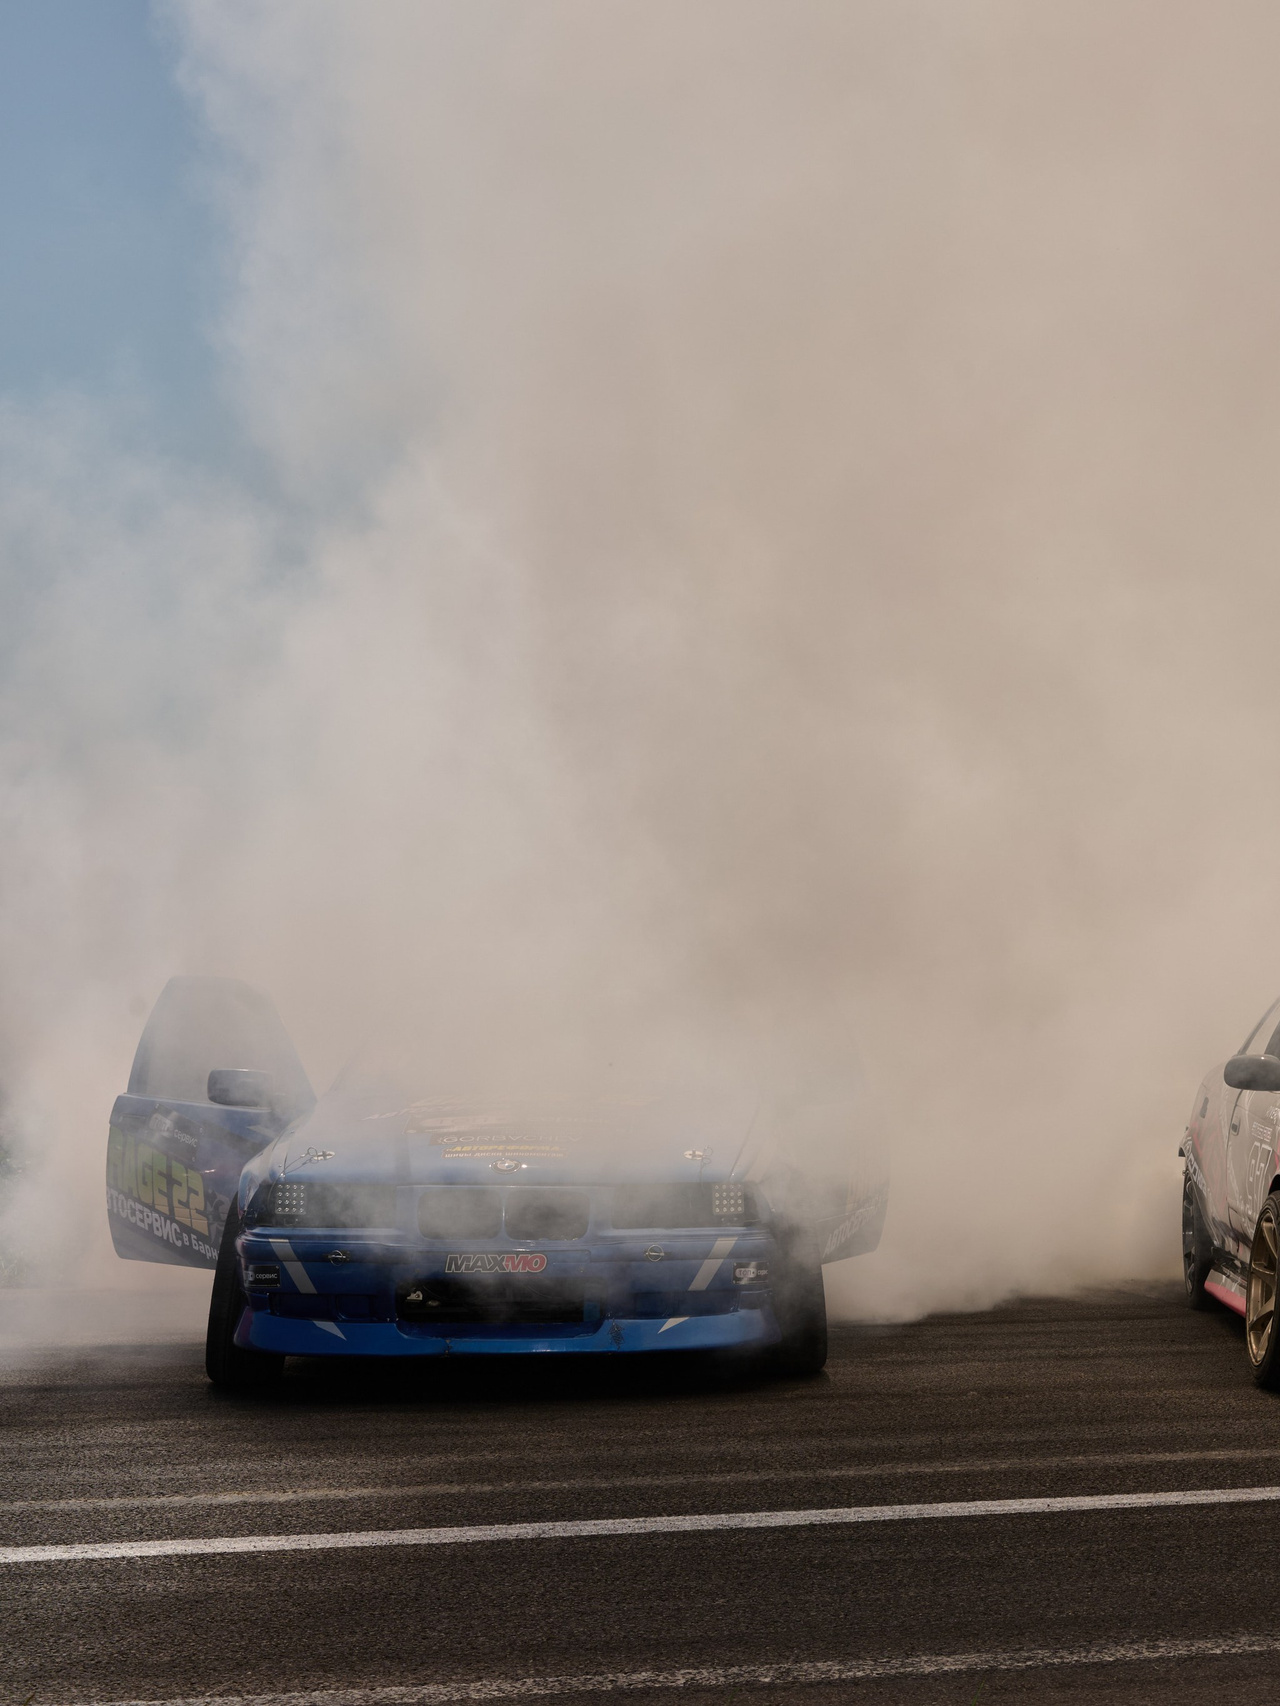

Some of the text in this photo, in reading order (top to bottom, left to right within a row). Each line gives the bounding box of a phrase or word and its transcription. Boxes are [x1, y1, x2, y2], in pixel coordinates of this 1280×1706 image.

[174, 1129, 198, 1147] сервис
[183, 1232, 190, 1246] в
[191, 1233, 220, 1260] Барн
[445, 1253, 548, 1273] MAXMO
